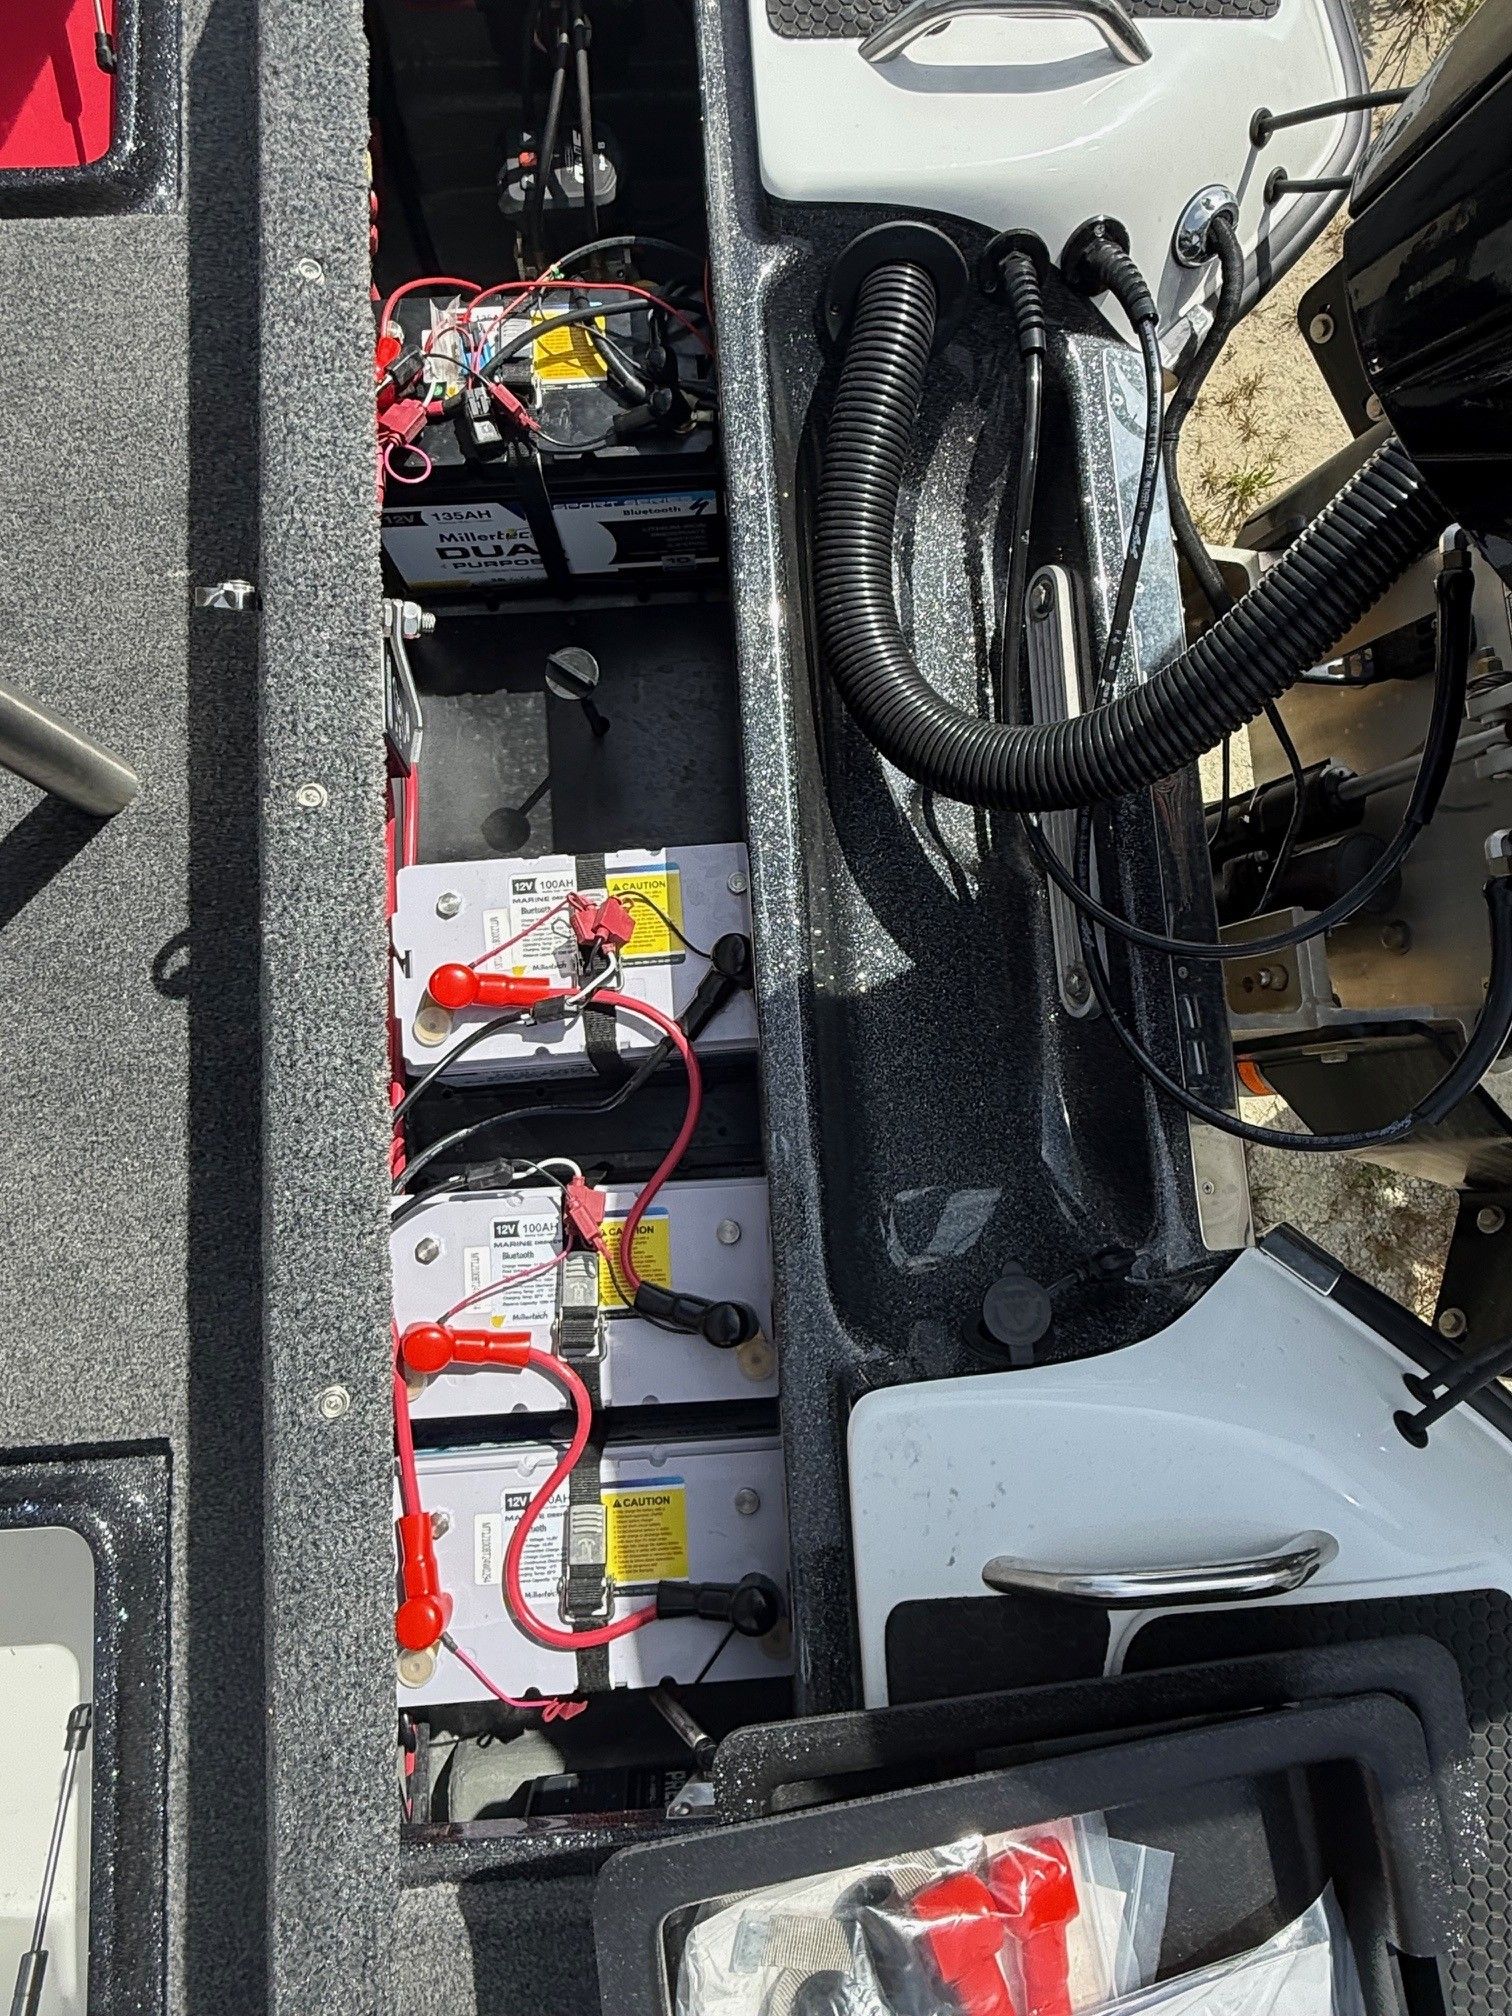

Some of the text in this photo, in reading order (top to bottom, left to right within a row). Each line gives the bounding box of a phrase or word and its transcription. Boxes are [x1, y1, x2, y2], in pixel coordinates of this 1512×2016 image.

[622, 505, 681, 516] Bluetooth
[384, 509, 492, 525] 12V 135AH
[435, 543, 541, 560] DUA
[514, 879, 574, 892] 12V 100AH
[621, 880, 666, 891] CAUTION
[512, 896, 550, 904] MARINE
[496, 1222, 558, 1235] 12V 100AH
[608, 1225, 655, 1236] CAION
[493, 1240, 533, 1248] MARINE
[502, 1250, 535, 1260] Bluetooth
[512, 1310, 549, 1321] Millertech
[506, 1495, 528, 1508] 12V
[622, 1496, 671, 1508] CAUTION
